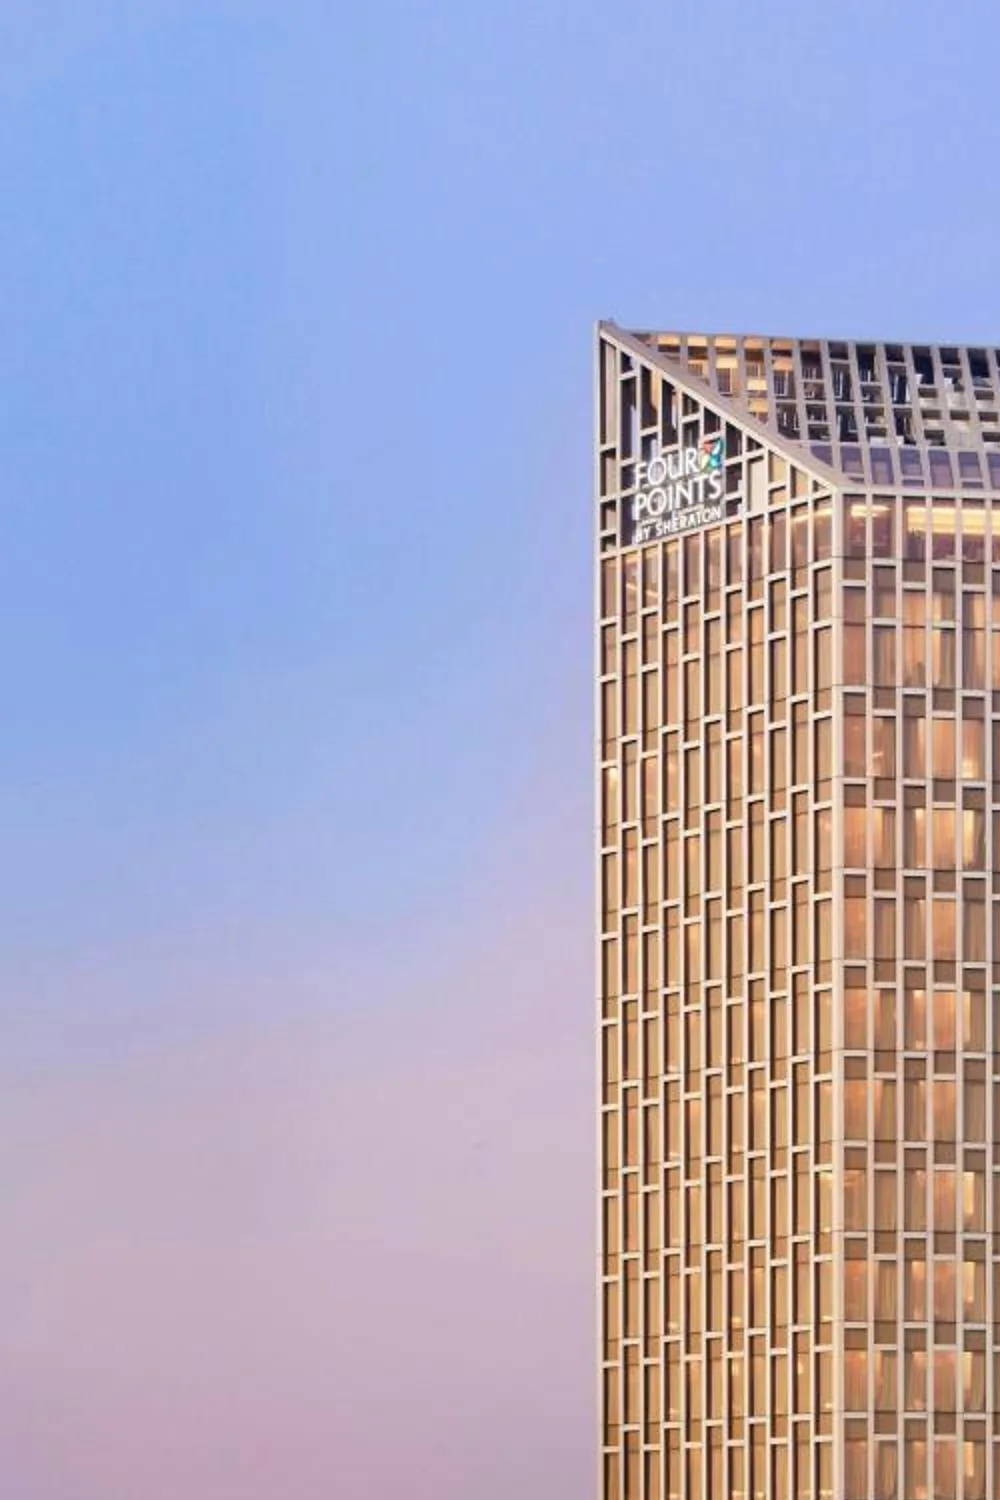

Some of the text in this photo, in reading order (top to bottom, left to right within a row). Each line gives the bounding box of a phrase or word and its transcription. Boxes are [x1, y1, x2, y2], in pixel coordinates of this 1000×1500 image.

[633, 447, 698, 489] FOUR
[632, 470, 722, 520] POINTS
[636, 505, 722, 543] BY SHERATON
